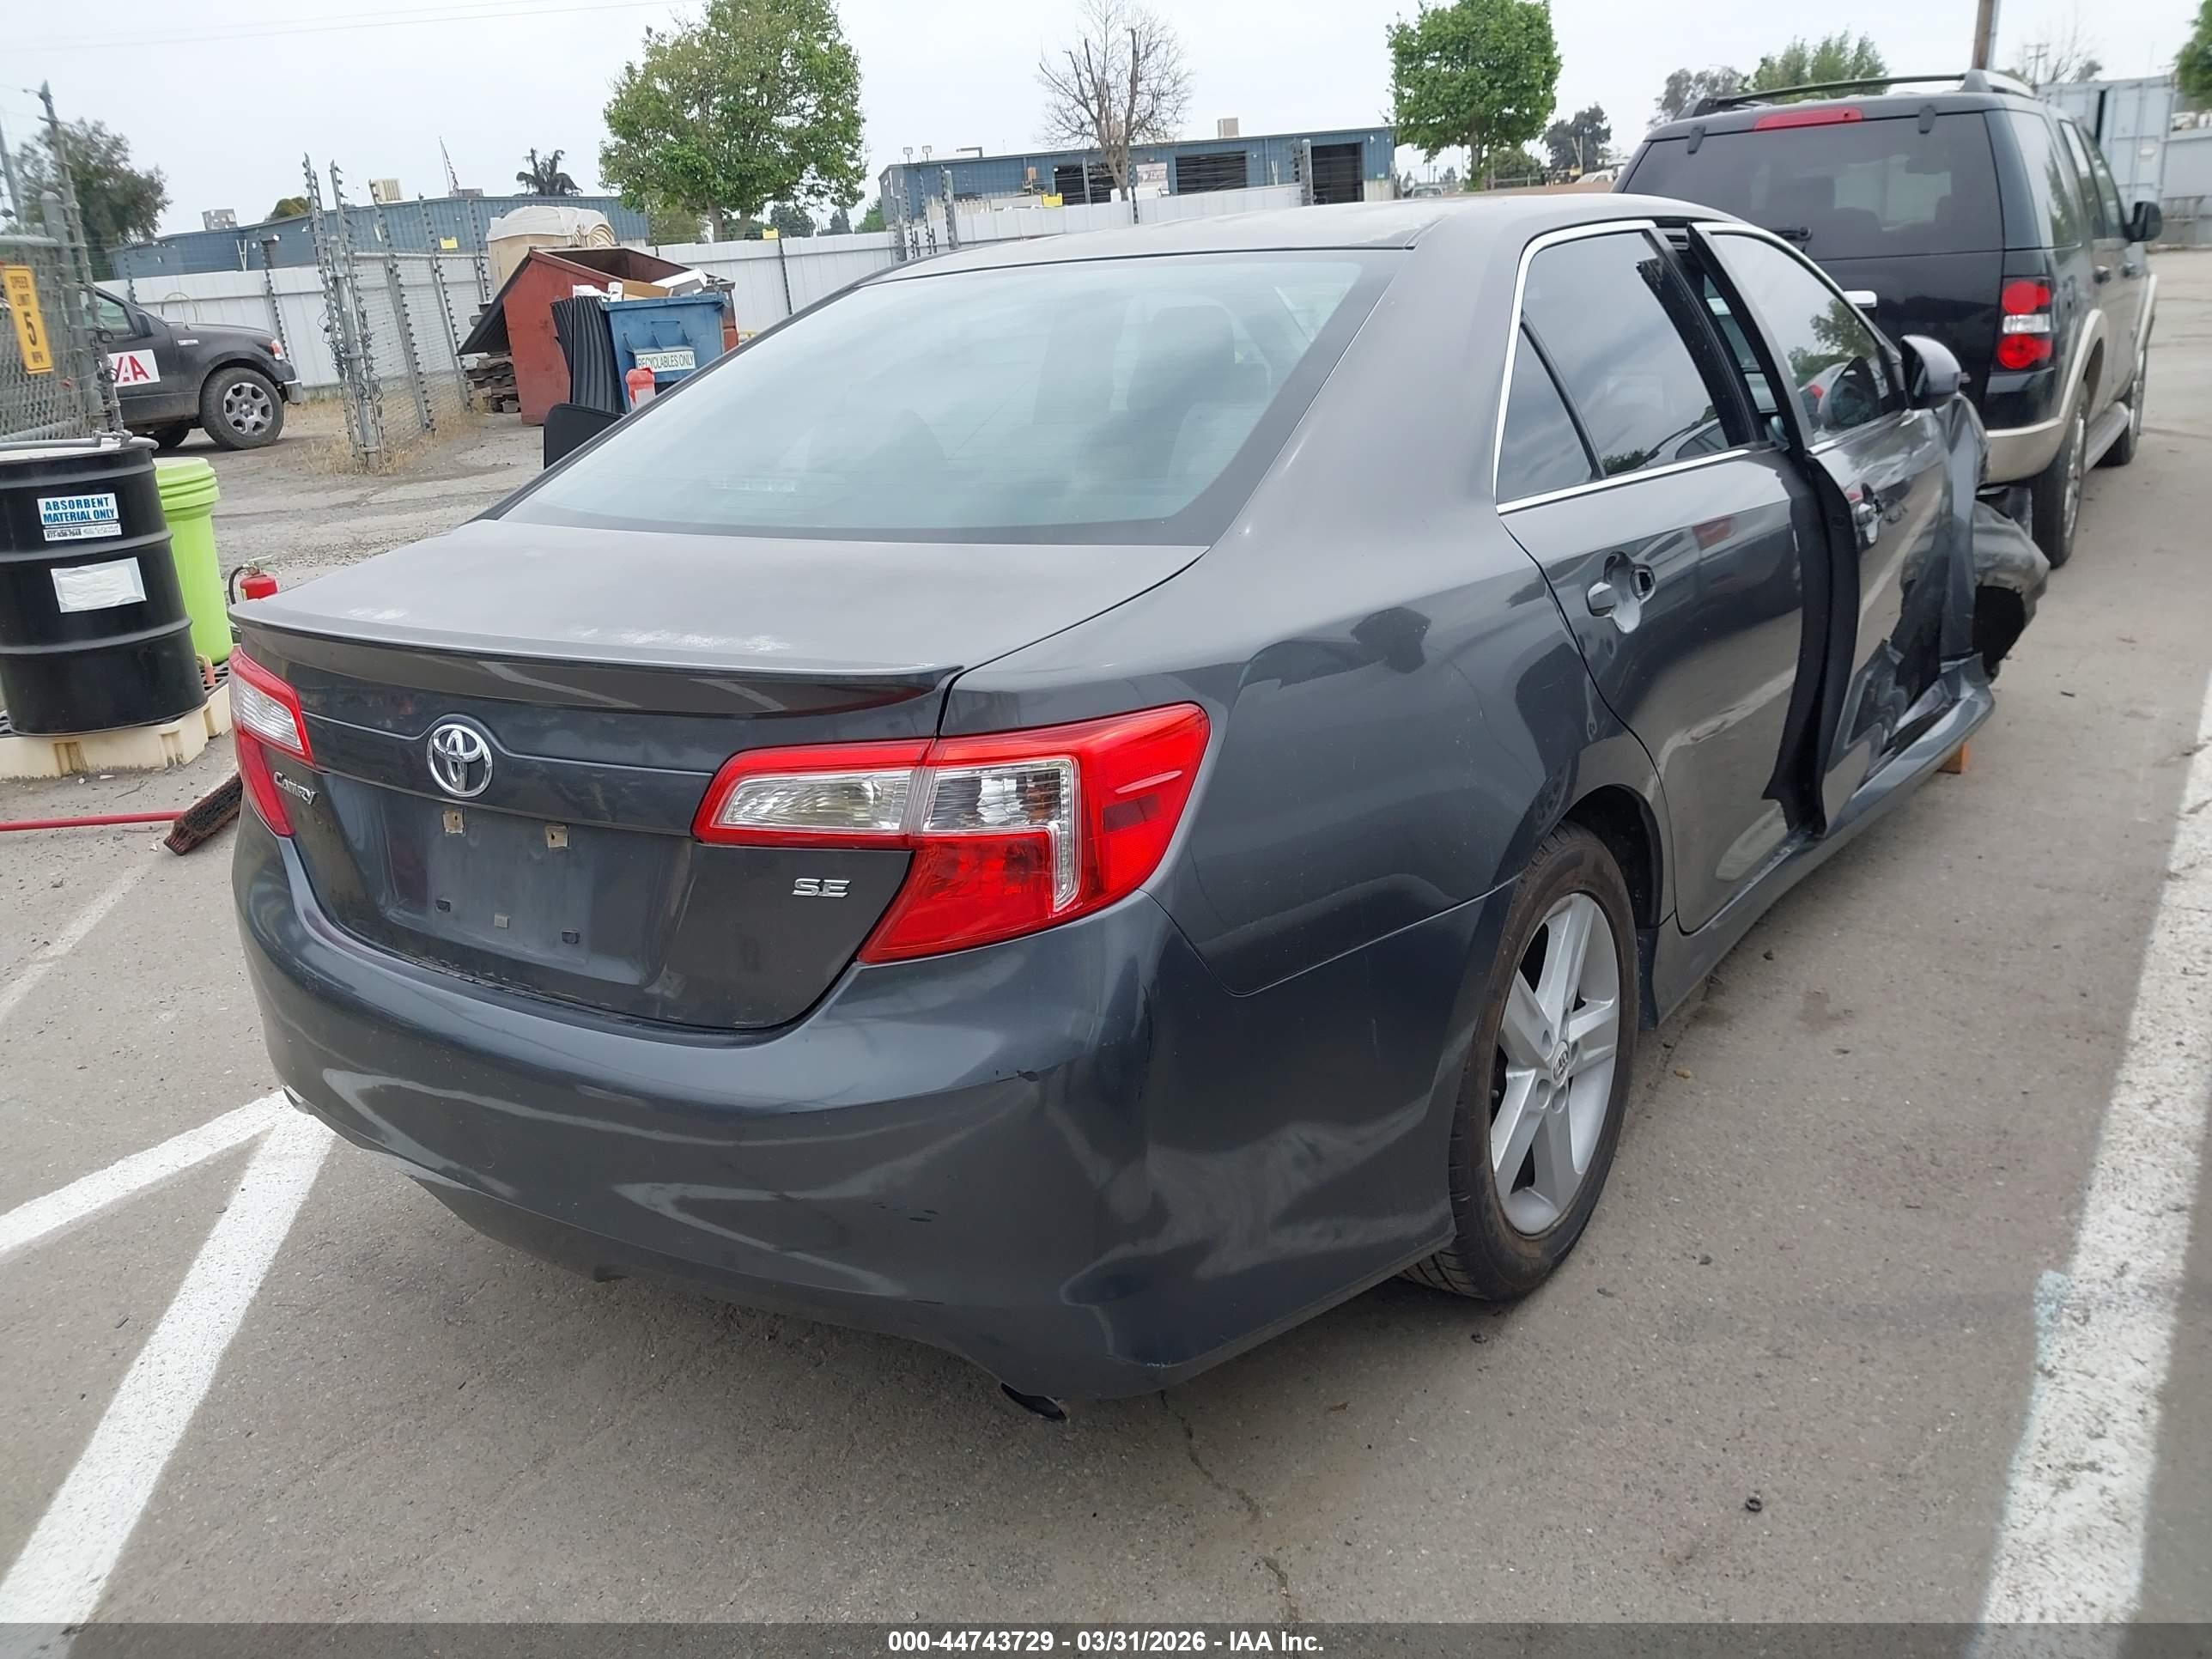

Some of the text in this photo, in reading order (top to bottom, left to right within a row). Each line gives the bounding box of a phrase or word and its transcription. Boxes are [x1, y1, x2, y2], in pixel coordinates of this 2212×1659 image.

[23, 312, 37, 346] 5
[679, 354, 694, 366] ONLY
[45, 497, 109, 512] ABSORBENT
[43, 507, 115, 524] MATERIAL ONLY
[792, 878, 851, 897] SE
